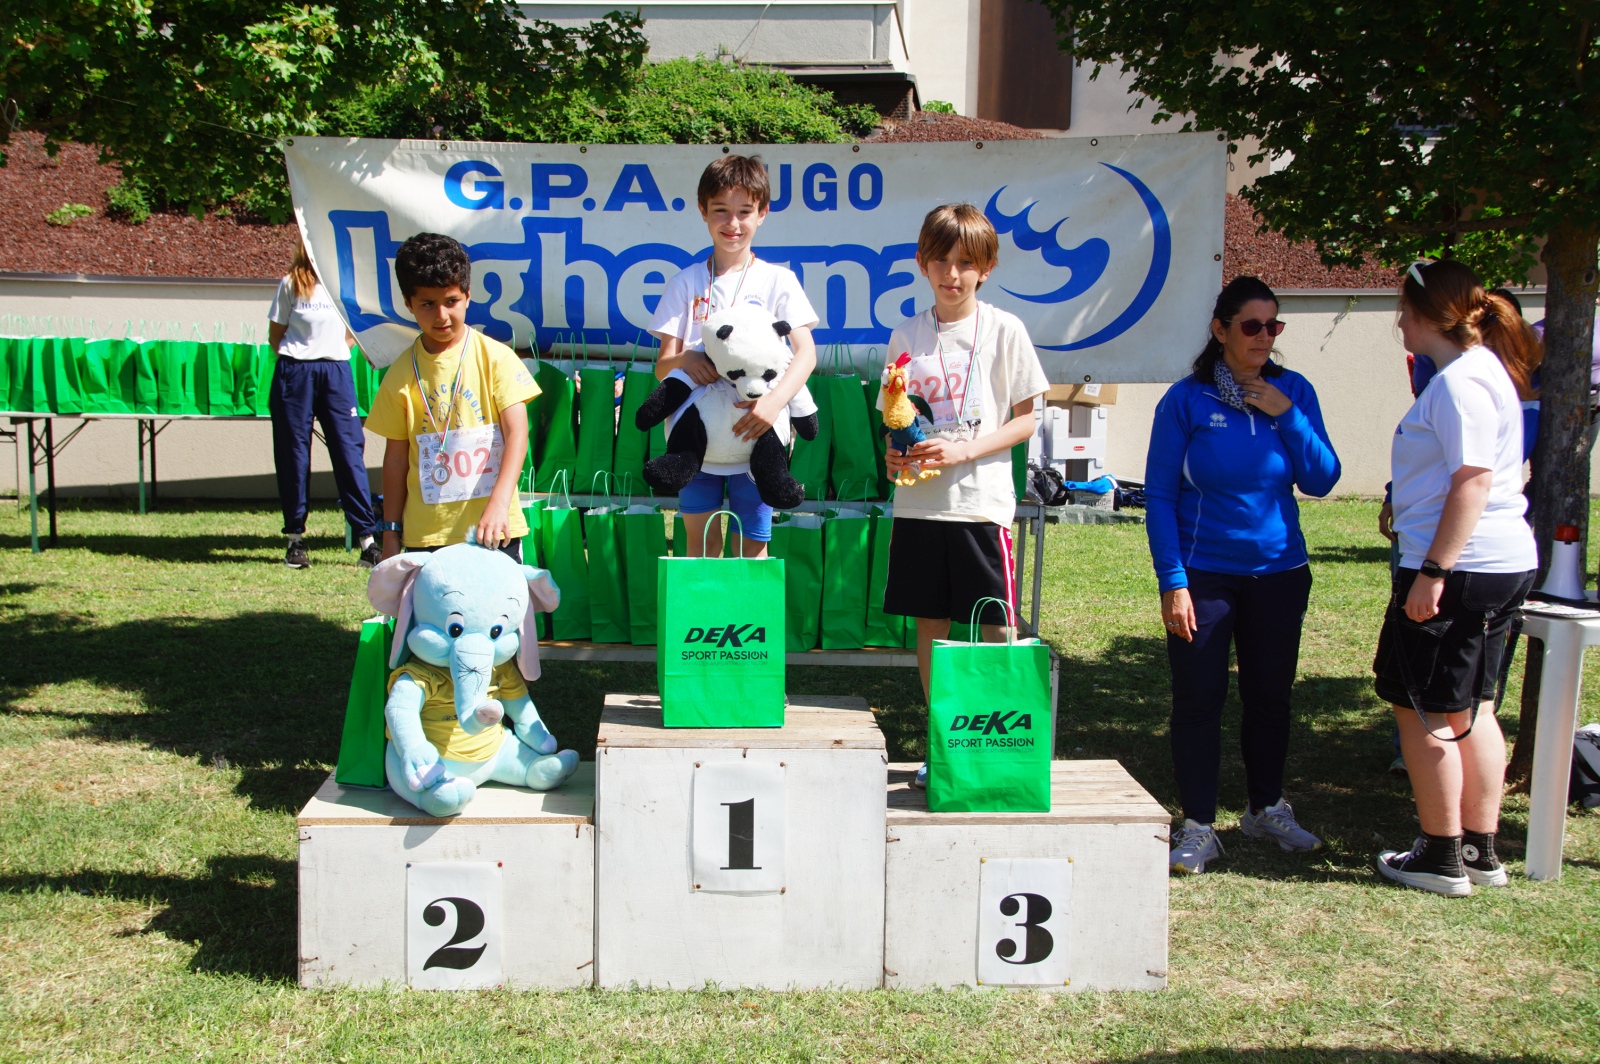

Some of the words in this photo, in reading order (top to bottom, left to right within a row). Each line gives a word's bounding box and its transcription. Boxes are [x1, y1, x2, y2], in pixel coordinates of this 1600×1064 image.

[443, 160, 685, 212] G.P.A.
[301, 301, 334, 311] lughe
[458, 384, 486, 422] IMOLA
[908, 372, 964, 404] 322
[435, 447, 493, 478] 302
[683, 623, 766, 648] DEKA
[681, 650, 717, 660] SPORT
[720, 650, 768, 660] PASSION
[949, 710, 1032, 735] DEKA
[947, 738, 982, 748] SPORT
[985, 737, 1035, 748] PASSION
[719, 797, 763, 871] 1
[422, 895, 488, 971] 2
[995, 892, 1054, 965] 3
